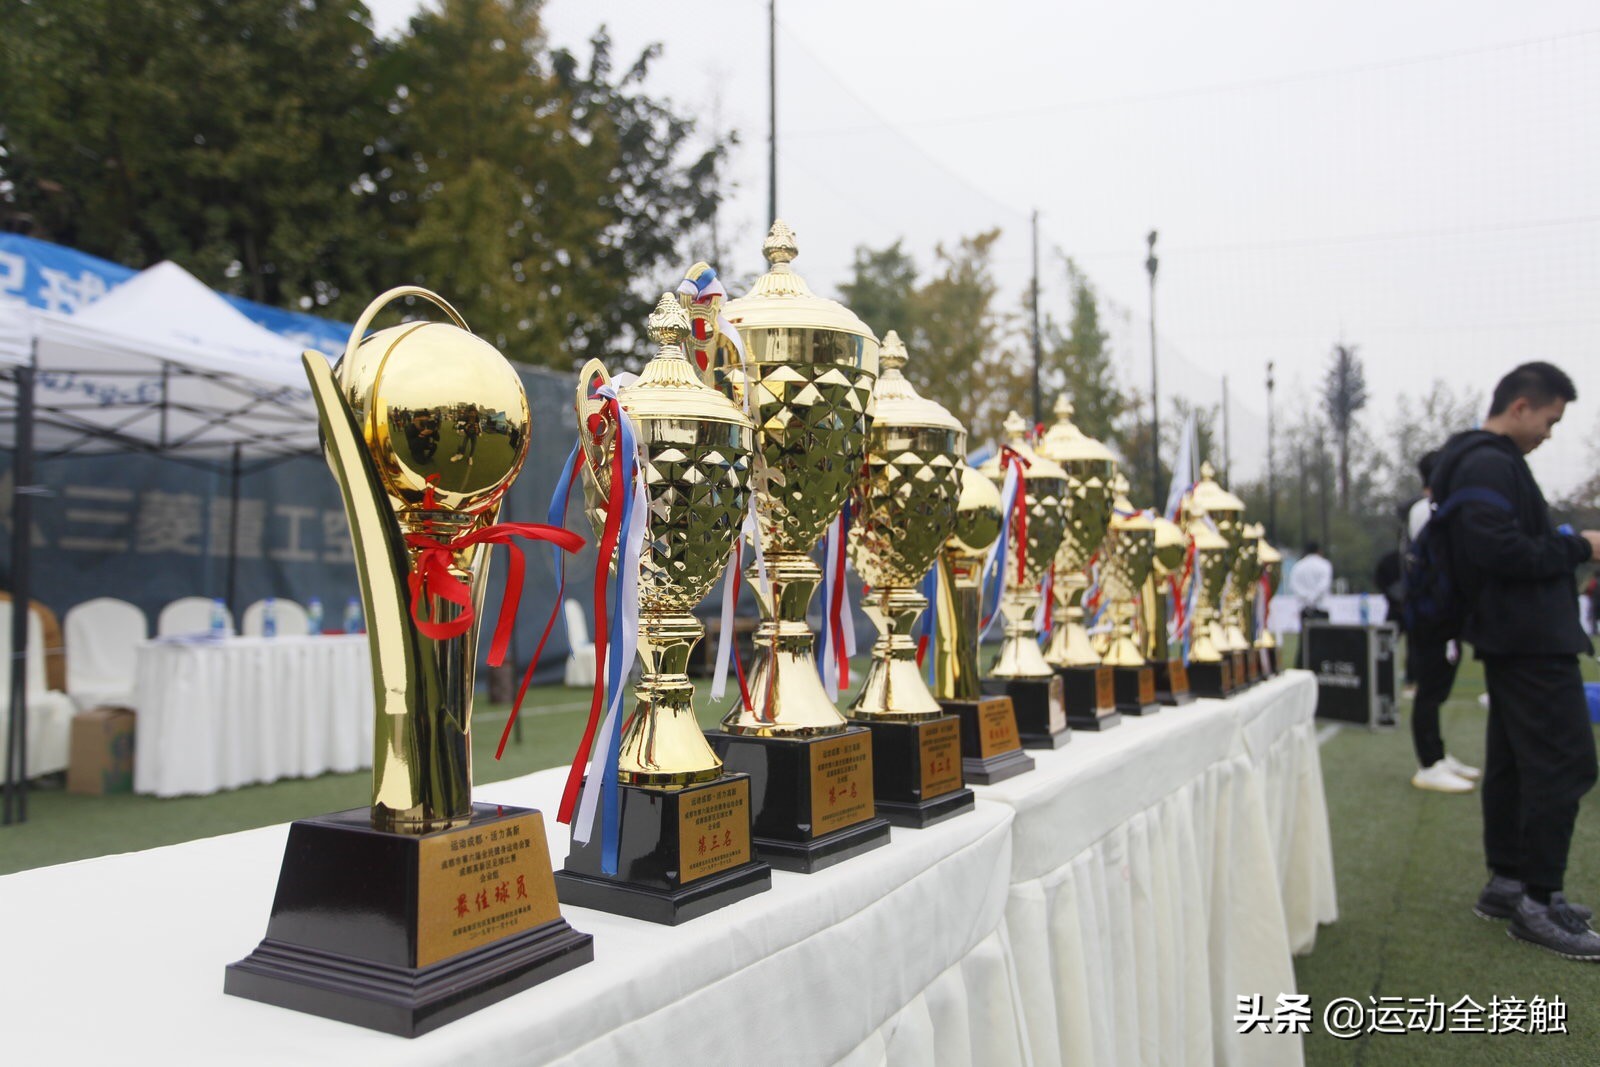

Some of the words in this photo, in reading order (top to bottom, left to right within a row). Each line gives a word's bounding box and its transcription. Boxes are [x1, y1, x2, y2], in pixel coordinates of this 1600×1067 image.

[697, 829, 732, 856] 第三名
[453, 875, 528, 918] 最佳球员
